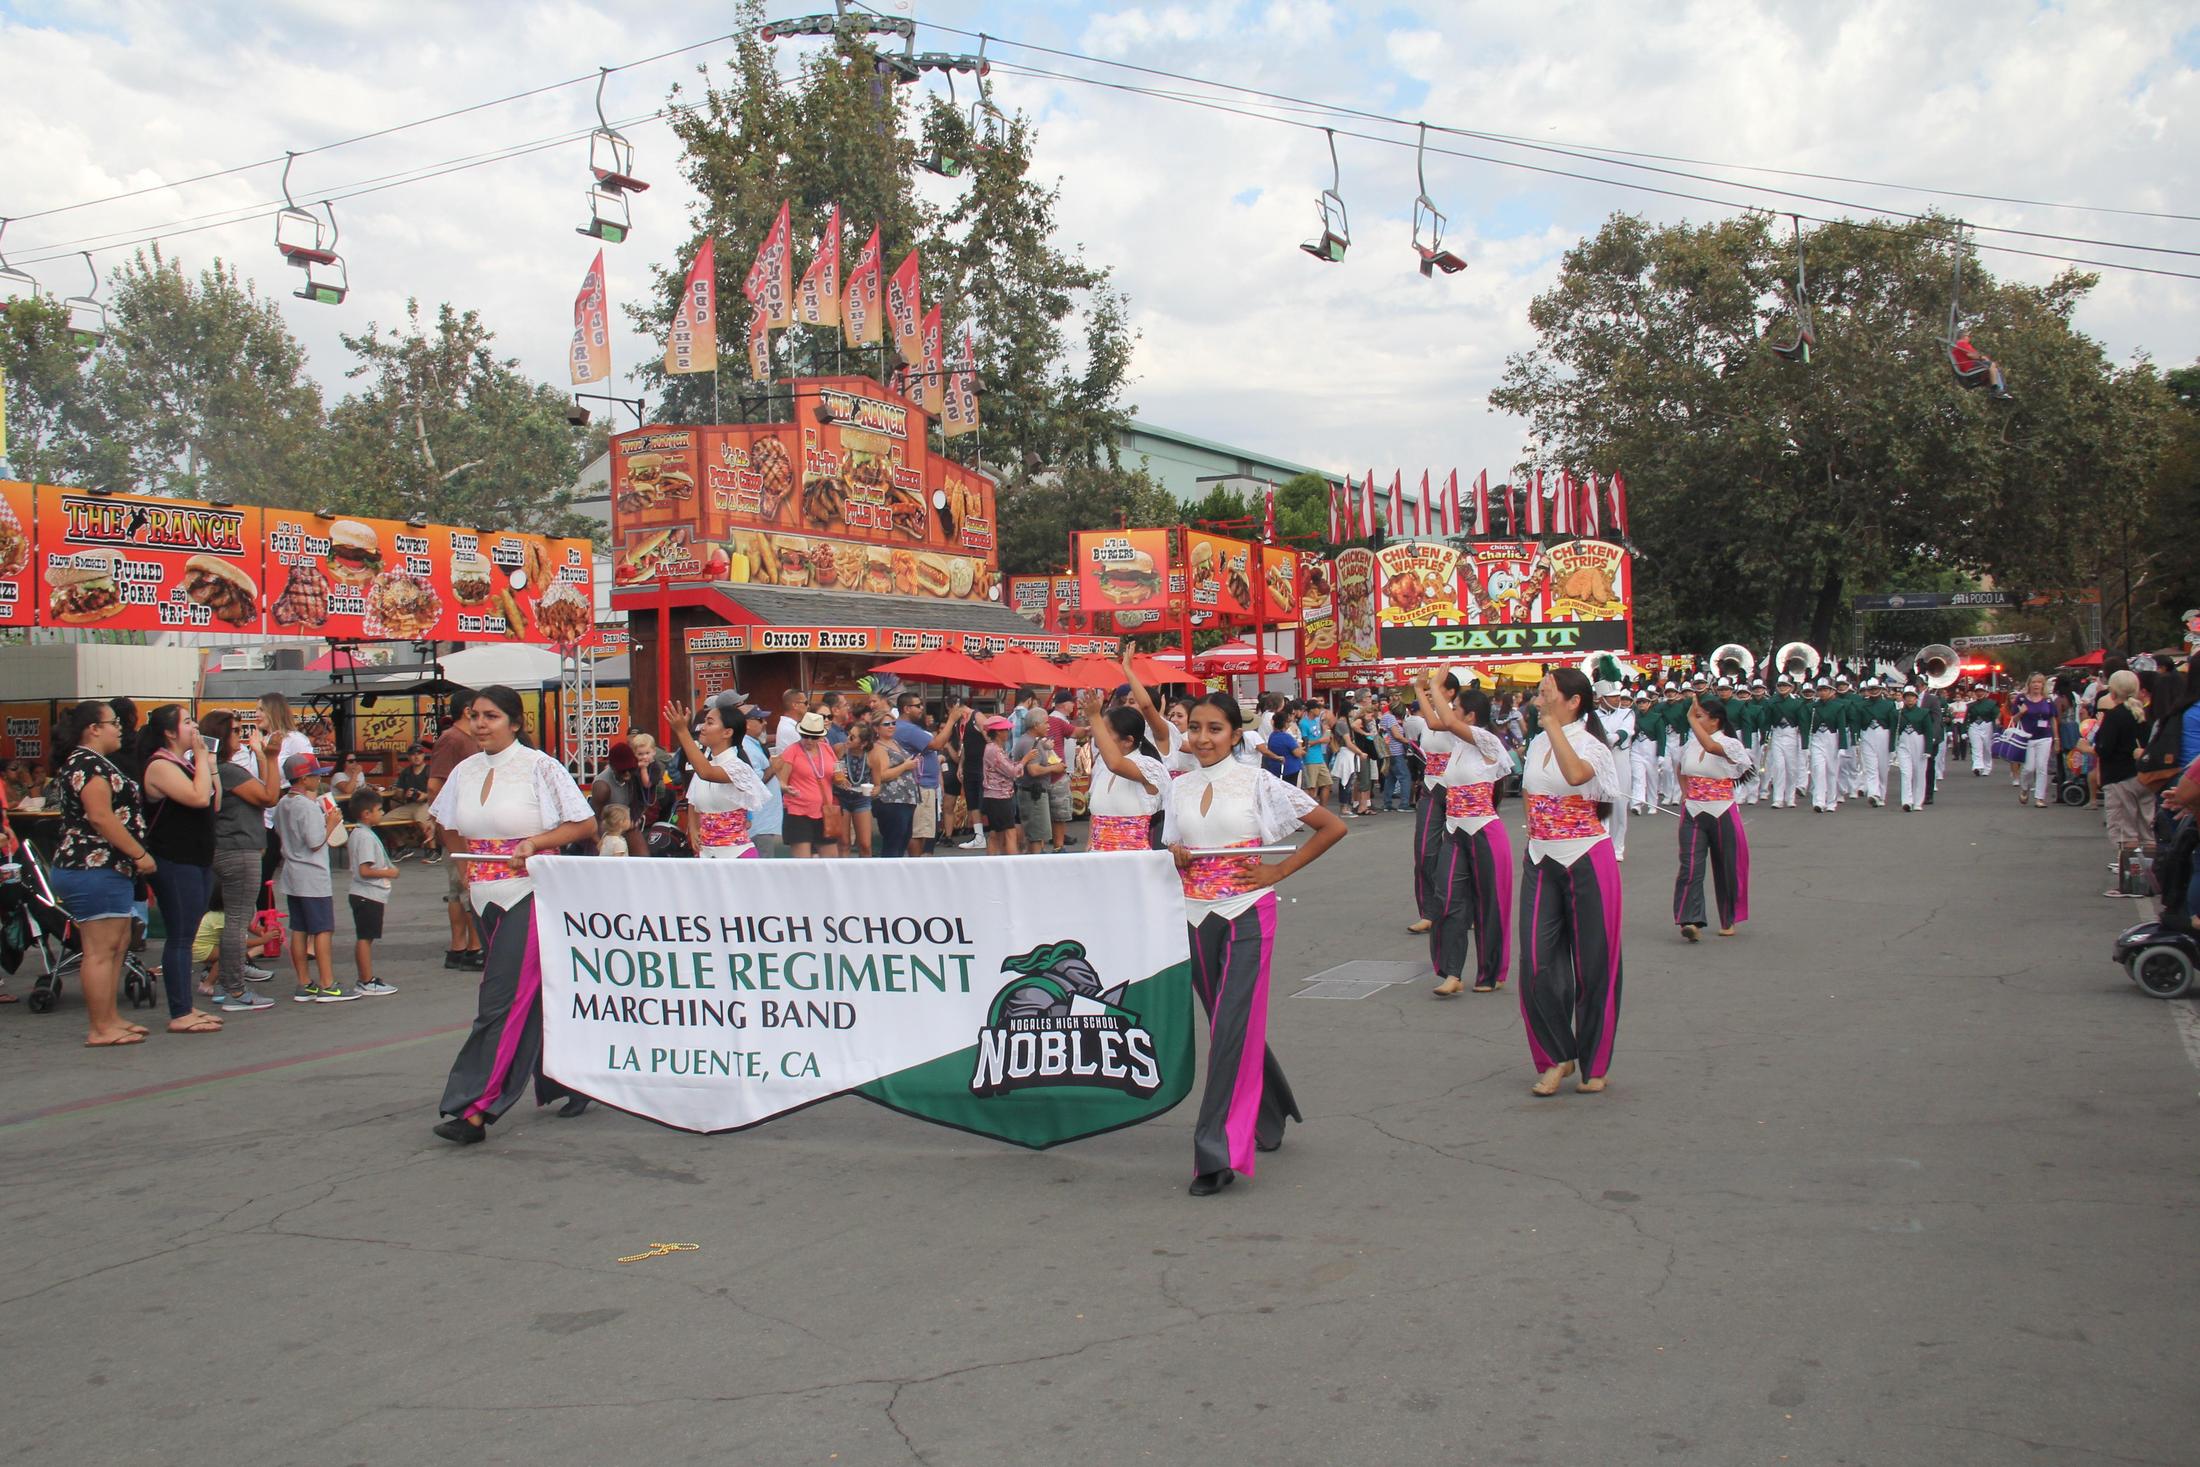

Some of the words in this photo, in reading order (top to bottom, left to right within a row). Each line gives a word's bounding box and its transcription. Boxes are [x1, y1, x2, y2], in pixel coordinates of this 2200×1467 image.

[861, 401, 906, 437] RANCH
[709, 466, 737, 489] PORK
[739, 471, 763, 493] CHOP
[65, 501, 125, 538] THE
[148, 511, 242, 550] RANCH
[271, 533, 300, 552] PORK
[304, 535, 330, 555] CHOP
[396, 535, 428, 554] COWBOY
[451, 533, 478, 551] BAYOU
[49, 553, 72, 567] SLOW
[75, 556, 107, 569] SMOKED
[279, 555, 289, 566] ON
[290, 555, 298, 566] A
[492, 547, 524, 566] TENDERS
[1093, 549, 1135, 561] BURGERS
[1339, 550, 1371, 568] CHICKEN
[1442, 551, 1454, 563] &
[1478, 550, 1530, 560] Charlies
[1552, 543, 1619, 561] CHCKEN
[113, 559, 163, 581] PULLED
[406, 557, 431, 576] FRIES
[1391, 559, 1446, 574] WAFFLES
[1563, 556, 1609, 570] STRIPS
[560, 566, 588, 583] TROUGH
[120, 582, 156, 604] PORK
[1015, 590, 1031, 599] PORK
[1970, 594, 1993, 603] POCO
[1994, 594, 2005, 603] LA
[159, 603, 212, 625] TRI-TIP
[328, 595, 366, 615] BURGER
[1392, 604, 1449, 621] ROTISSERIE
[458, 614, 482, 631] FRIED
[484, 615, 506, 633] DILLS
[690, 637, 743, 648] CHEESEBURGER
[764, 632, 810, 647] ONION
[819, 632, 866, 647] RINGS
[893, 632, 917, 649] FRIED
[921, 633, 943, 649] DILLS
[985, 636, 1005, 652] FRIED
[1089, 641, 1101, 653] HOT
[1430, 629, 1527, 651] EAT
[1531, 627, 1580, 648] IT
[371, 716, 397, 735] PIG
[569, 715, 619, 735] TKEY
[582, 739, 609, 757] EGS
[563, 911, 711, 943] NOGALES
[722, 916, 810, 944] HIGH
[824, 916, 974, 945] SCHOOL
[570, 946, 715, 989] NOBLE
[730, 951, 976, 993] REGIMENT
[571, 993, 747, 1030] MARCHING
[760, 998, 857, 1030] BAND
[1009, 1018, 1050, 1031] NOGALES
[1053, 1017, 1079, 1030] HIGH
[1083, 1016, 1119, 1030] SCHOOL
[608, 1044, 640, 1071] LA
[650, 1047, 767, 1082] PUENTE,
[780, 1050, 822, 1078] CA
[972, 1028, 1162, 1090] NOBLES
